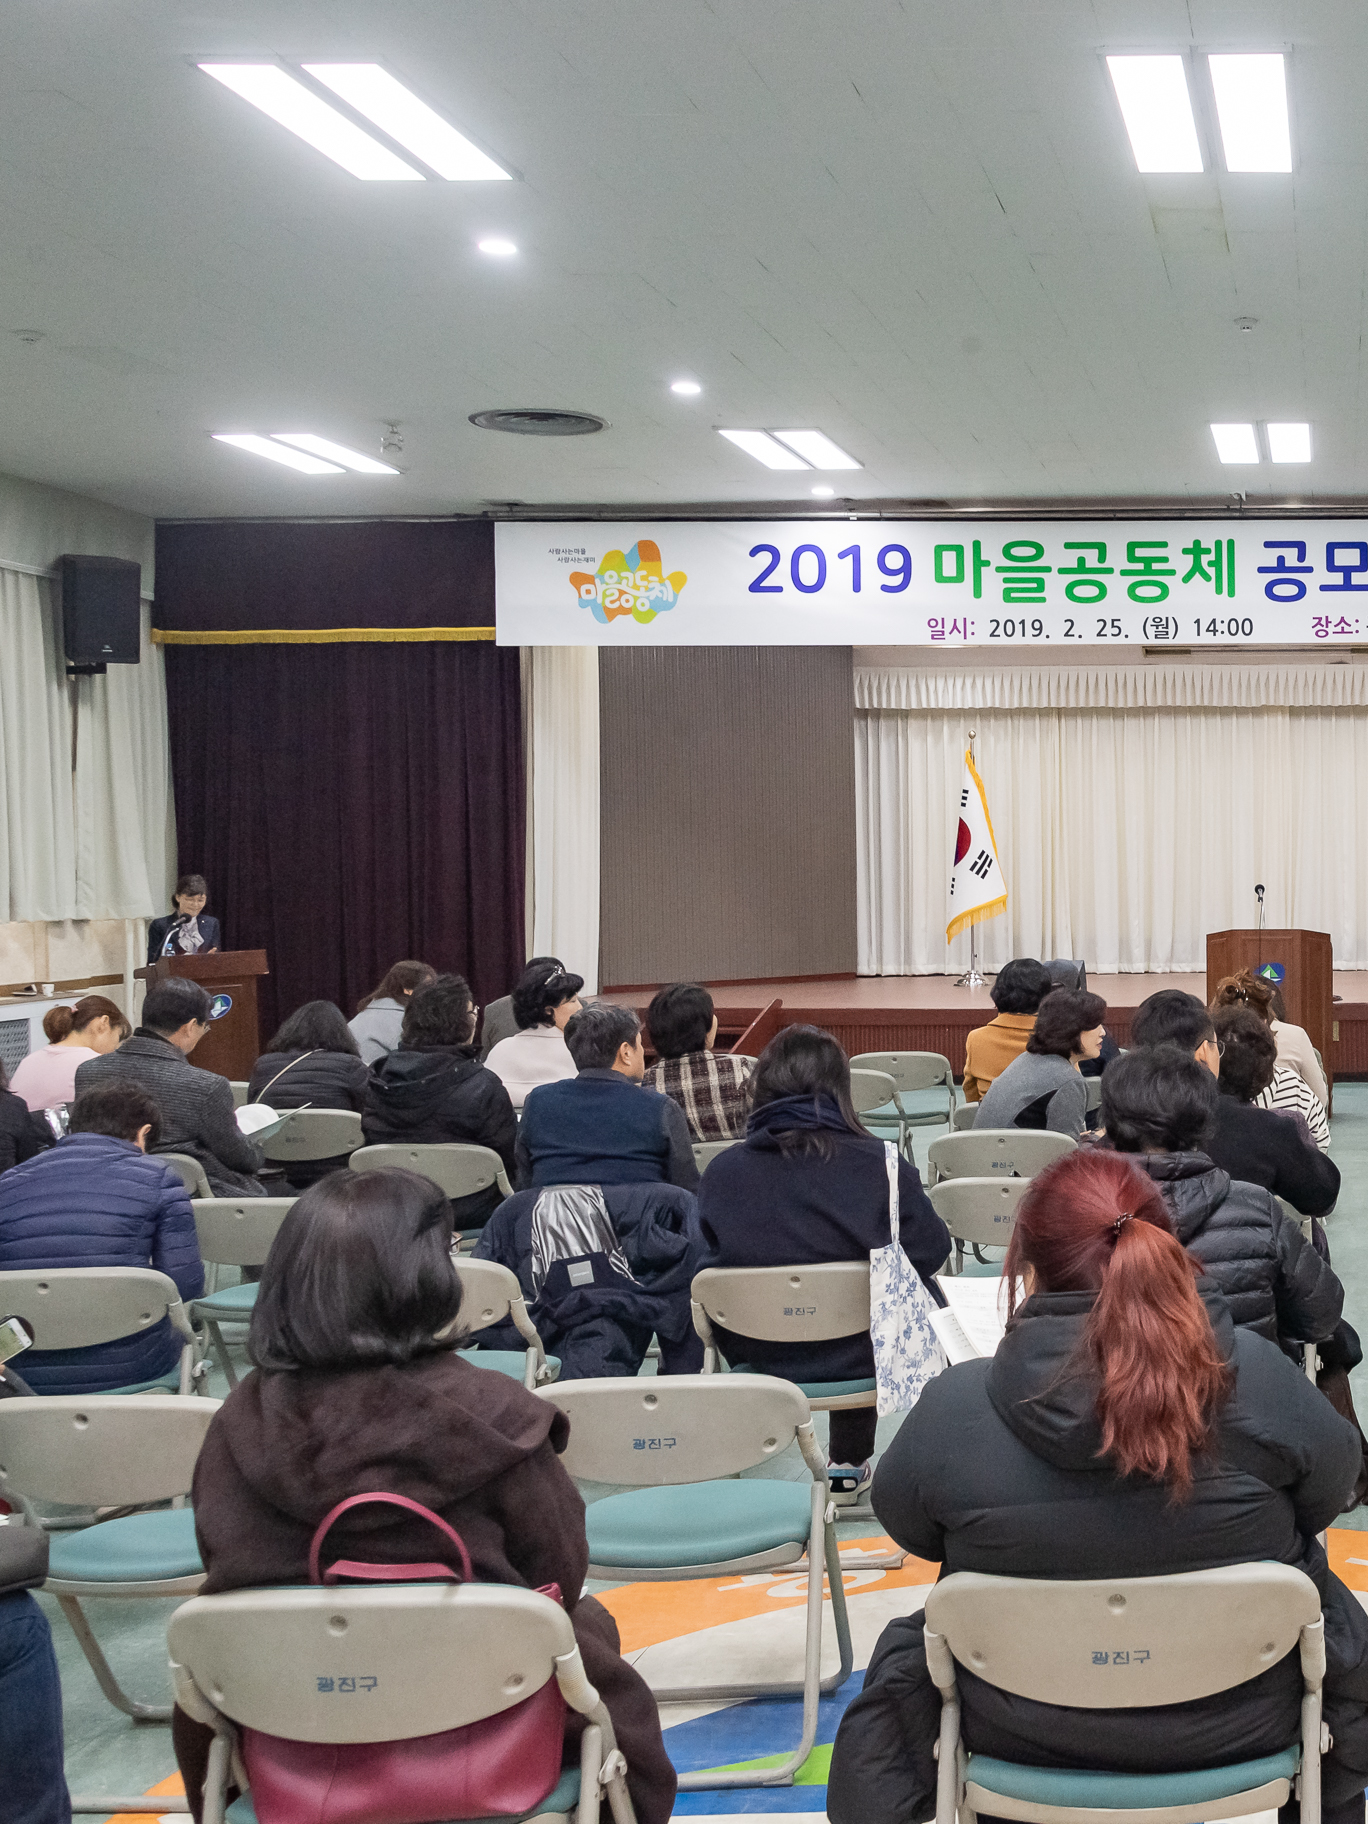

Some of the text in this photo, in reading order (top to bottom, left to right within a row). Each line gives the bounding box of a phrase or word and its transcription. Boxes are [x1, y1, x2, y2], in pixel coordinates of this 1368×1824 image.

[748, 543, 912, 594] 2019
[933, 538, 1236, 604] 마을공동체
[927, 616, 1254, 641] 일시: 2019. 2. 25. (월) 14:00
[1311, 615, 1360, 639] 장소:
[783, 1306, 817, 1317] 광진구
[632, 1437, 678, 1451] 광진구
[1091, 1649, 1152, 1666] 광진구
[316, 1675, 379, 1694] 광진구
